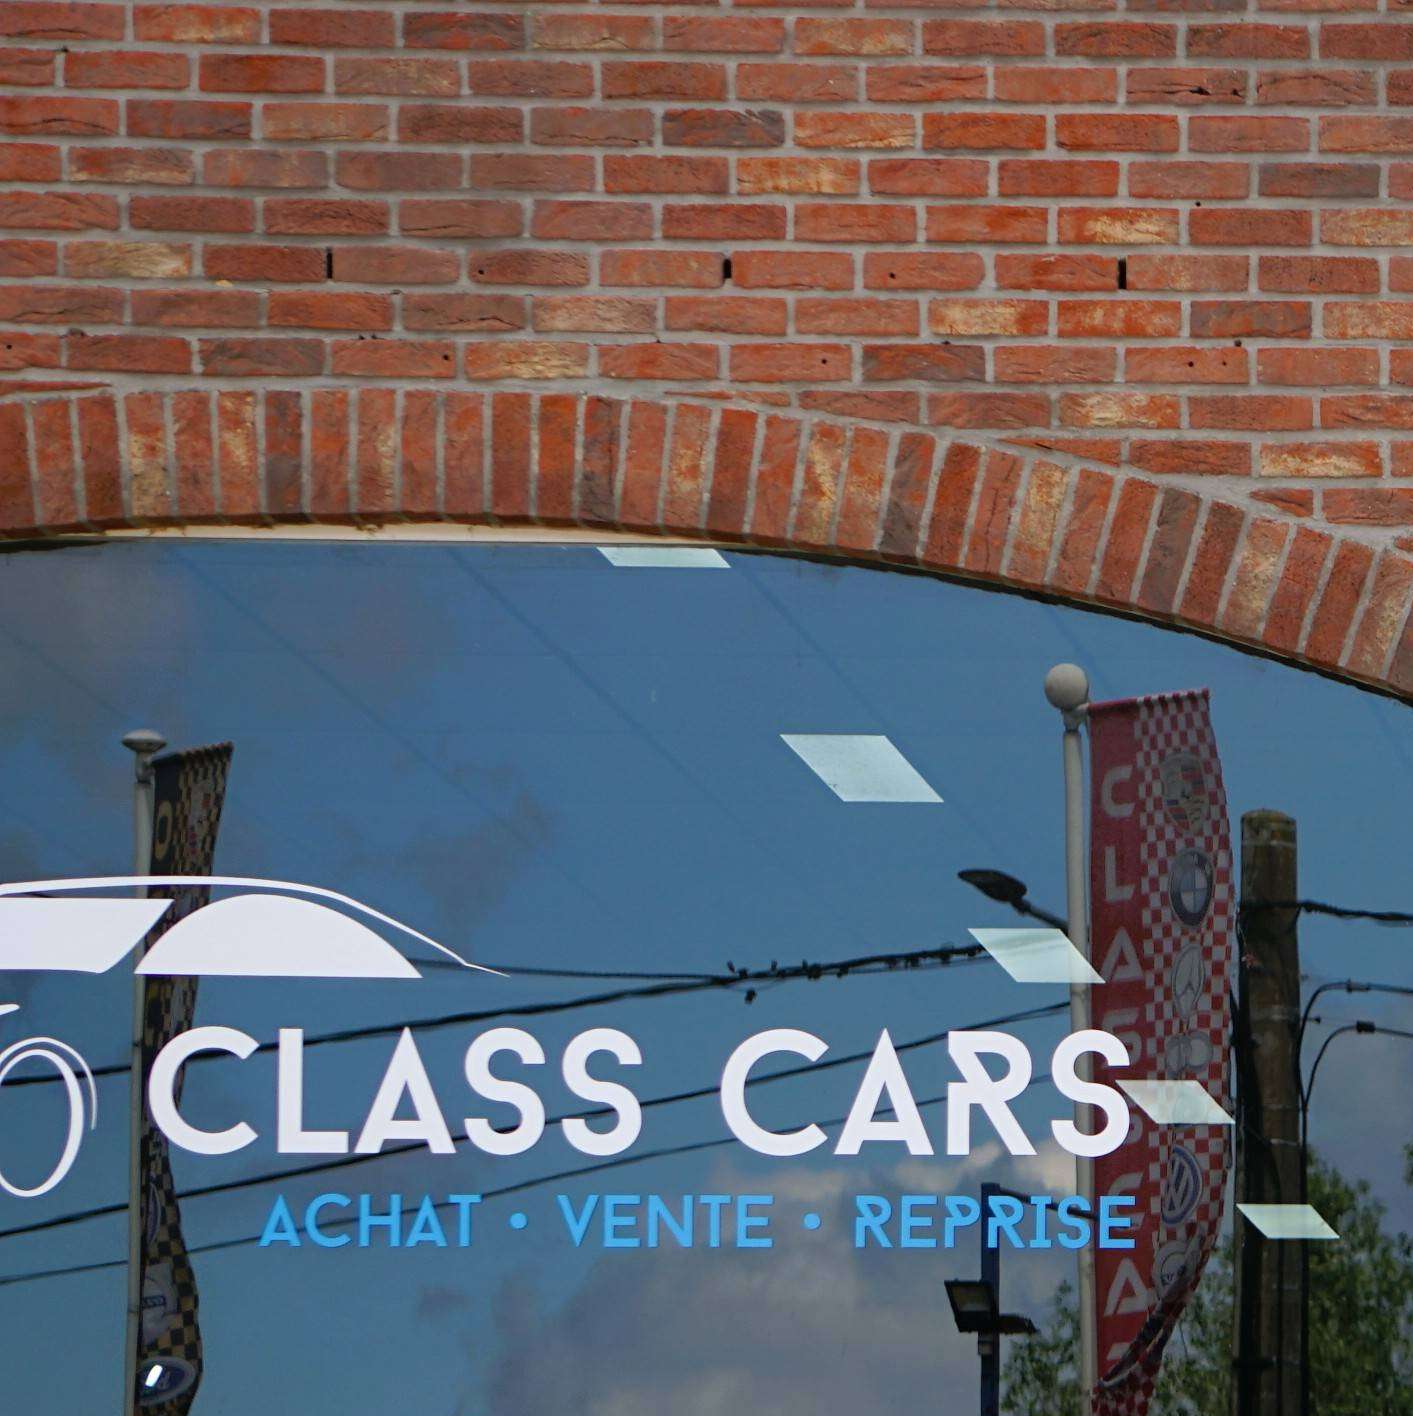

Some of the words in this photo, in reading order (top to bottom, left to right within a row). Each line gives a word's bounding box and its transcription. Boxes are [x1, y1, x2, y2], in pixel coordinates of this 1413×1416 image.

[149, 1026, 643, 1156] CLASS
[720, 1026, 1131, 1157] CARS
[255, 1190, 484, 1250] ACHAT
[553, 1190, 775, 1252] VENTE
[851, 1193, 1137, 1252] REPRISE
